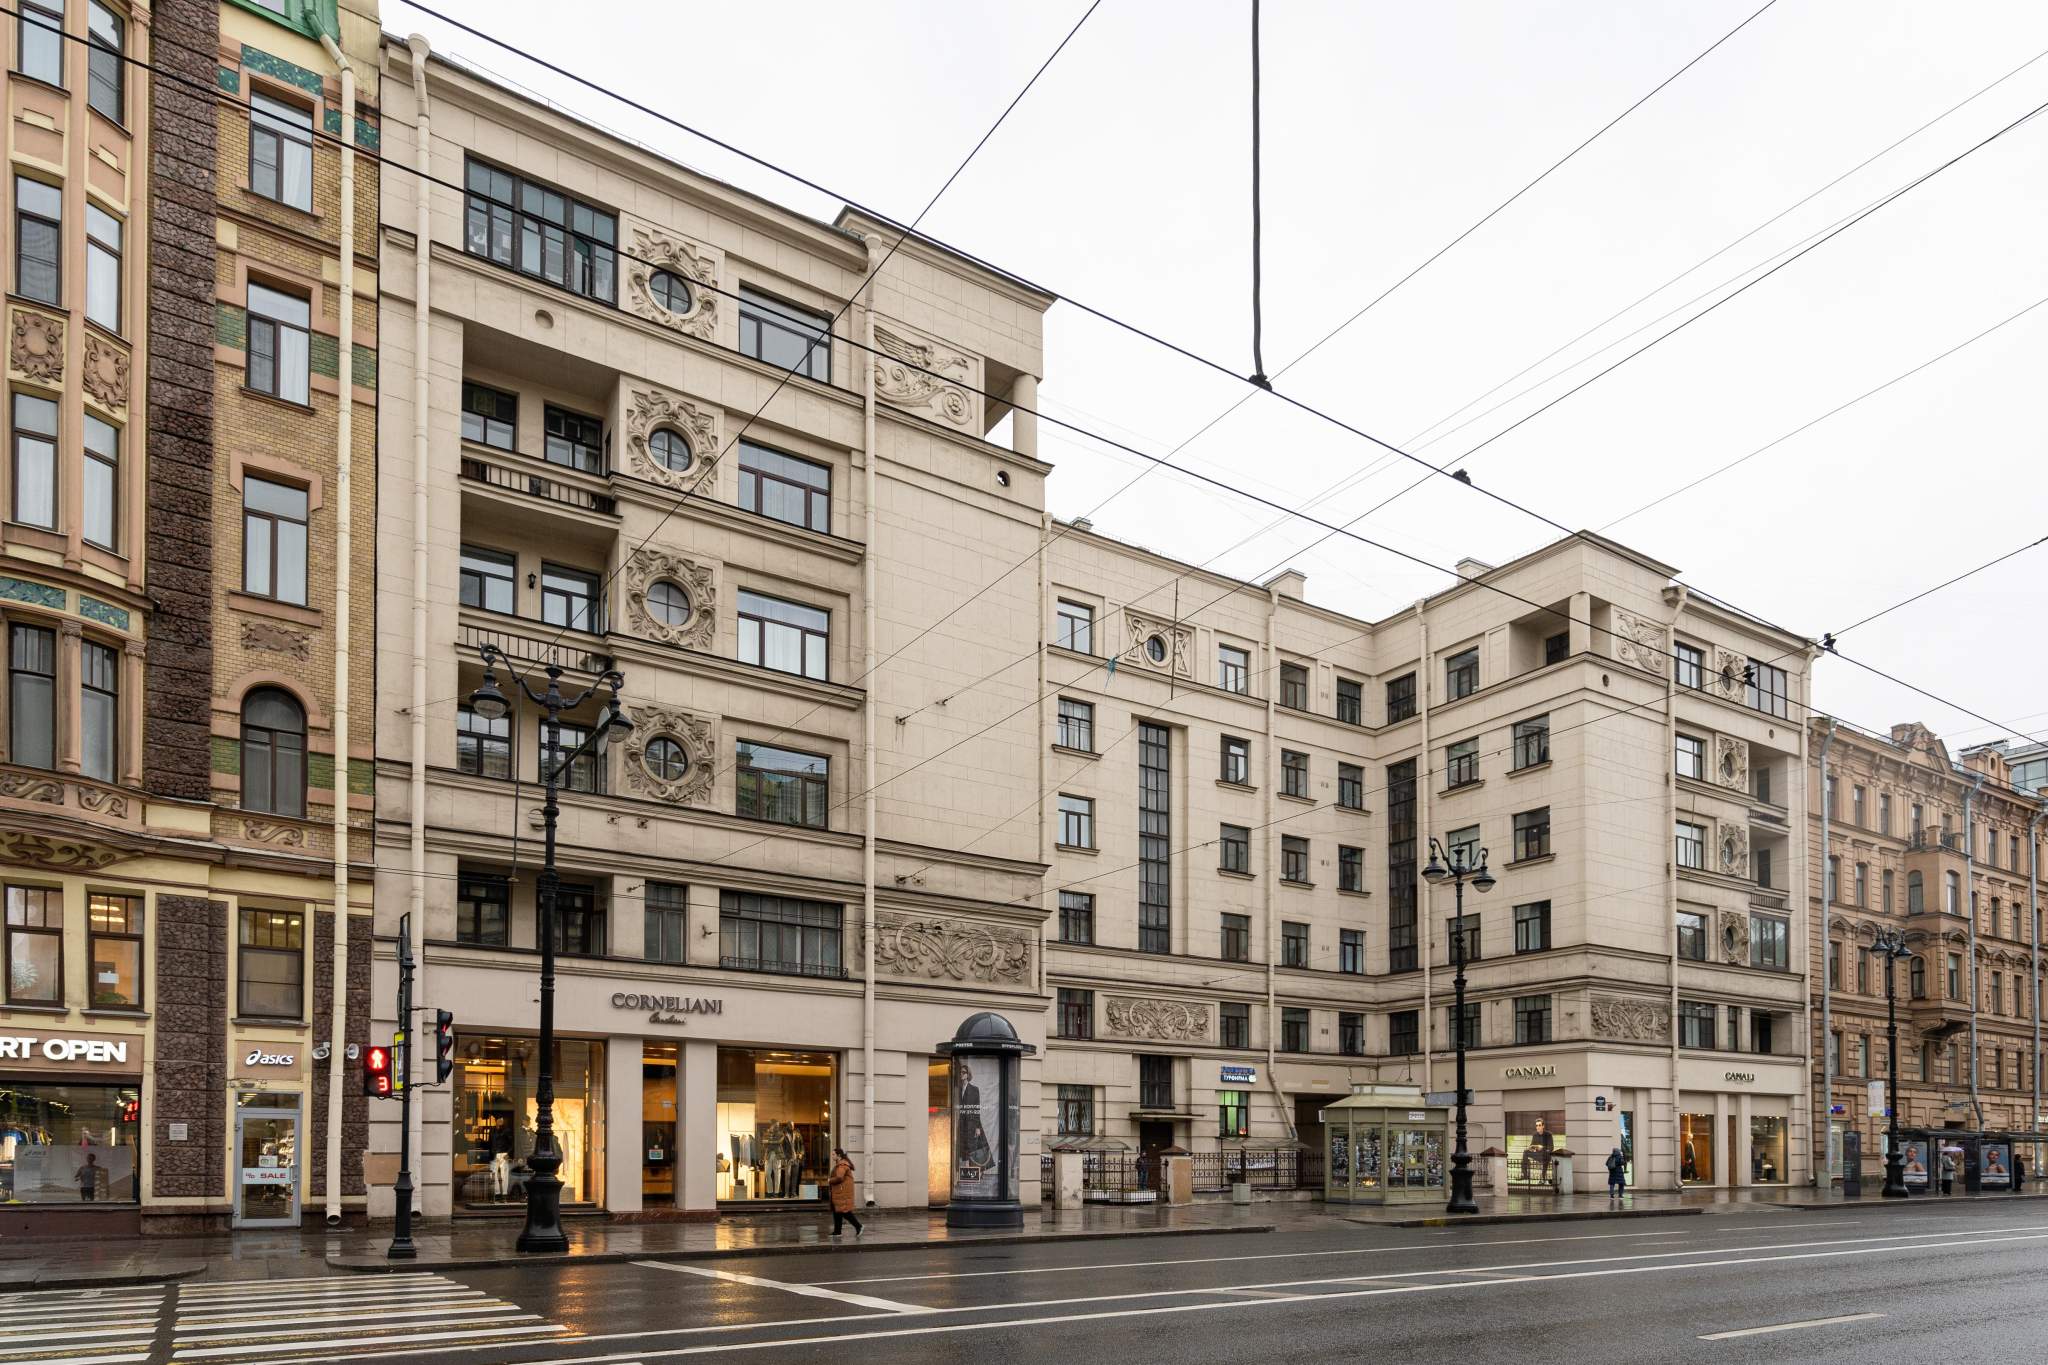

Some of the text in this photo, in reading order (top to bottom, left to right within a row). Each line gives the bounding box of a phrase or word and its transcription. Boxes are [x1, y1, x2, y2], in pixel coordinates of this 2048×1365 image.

[611, 992, 722, 1015] CORNELIANI
[0, 1037, 127, 1063] RT OPEN
[1505, 1065, 1556, 1078] CANALI
[1724, 1071, 1755, 1082] CANALI
[378, 1076, 388, 1092] 3
